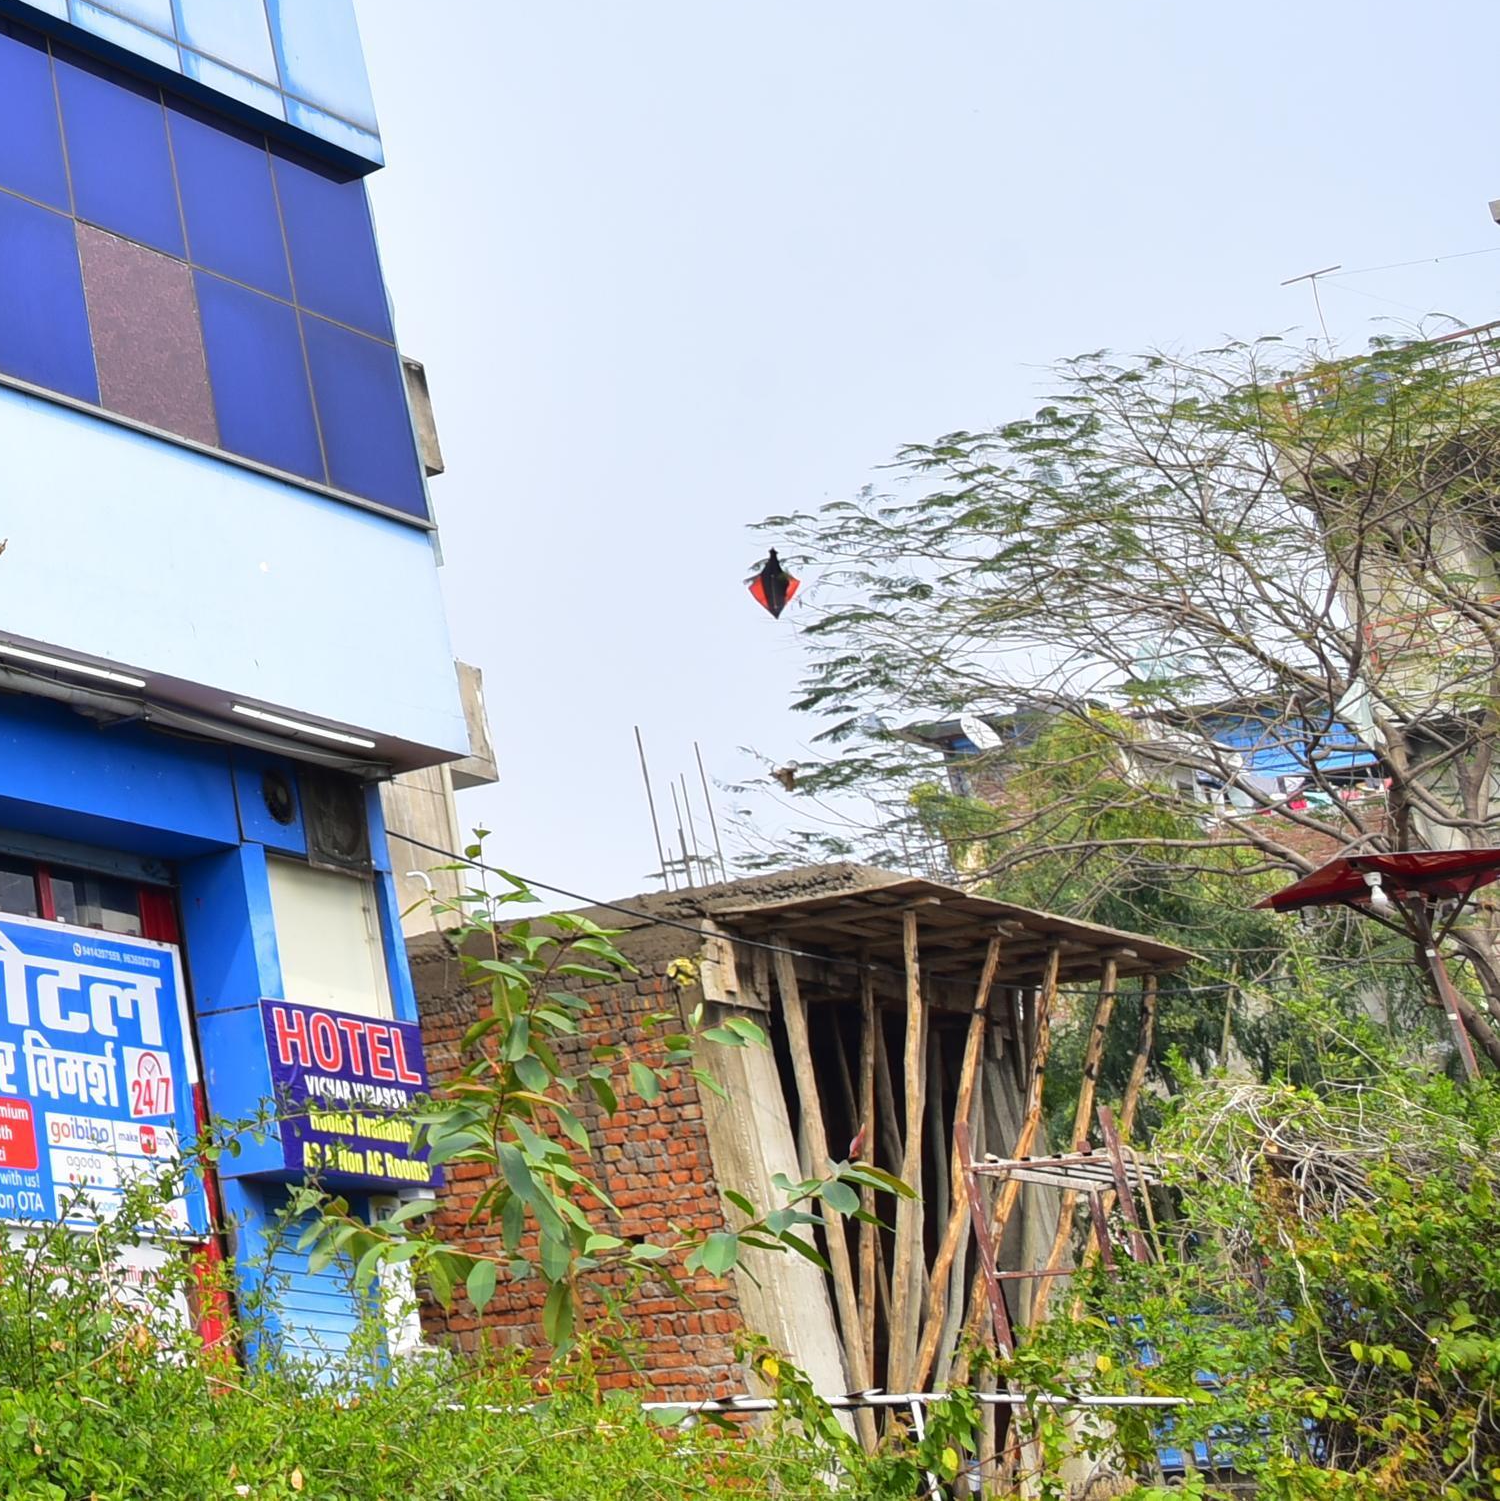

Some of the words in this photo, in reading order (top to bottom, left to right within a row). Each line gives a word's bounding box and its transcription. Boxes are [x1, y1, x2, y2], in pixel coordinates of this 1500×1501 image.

[272, 1006, 423, 1086] HOTEL
[21, 1028, 121, 1108] विमर्श
[131, 1076, 171, 1117] 24/7
[303, 1074, 352, 1101] VICHAR
[50, 1116, 109, 1144] goibibo
[66, 1154, 102, 1171] agoda
[366, 1149, 384, 1177] AC
[384, 1152, 431, 1183] Rooms
[0, 1172, 24, 1187] with
[24, 1173, 41, 1189] us!
[18, 1192, 46, 1213] OTA
